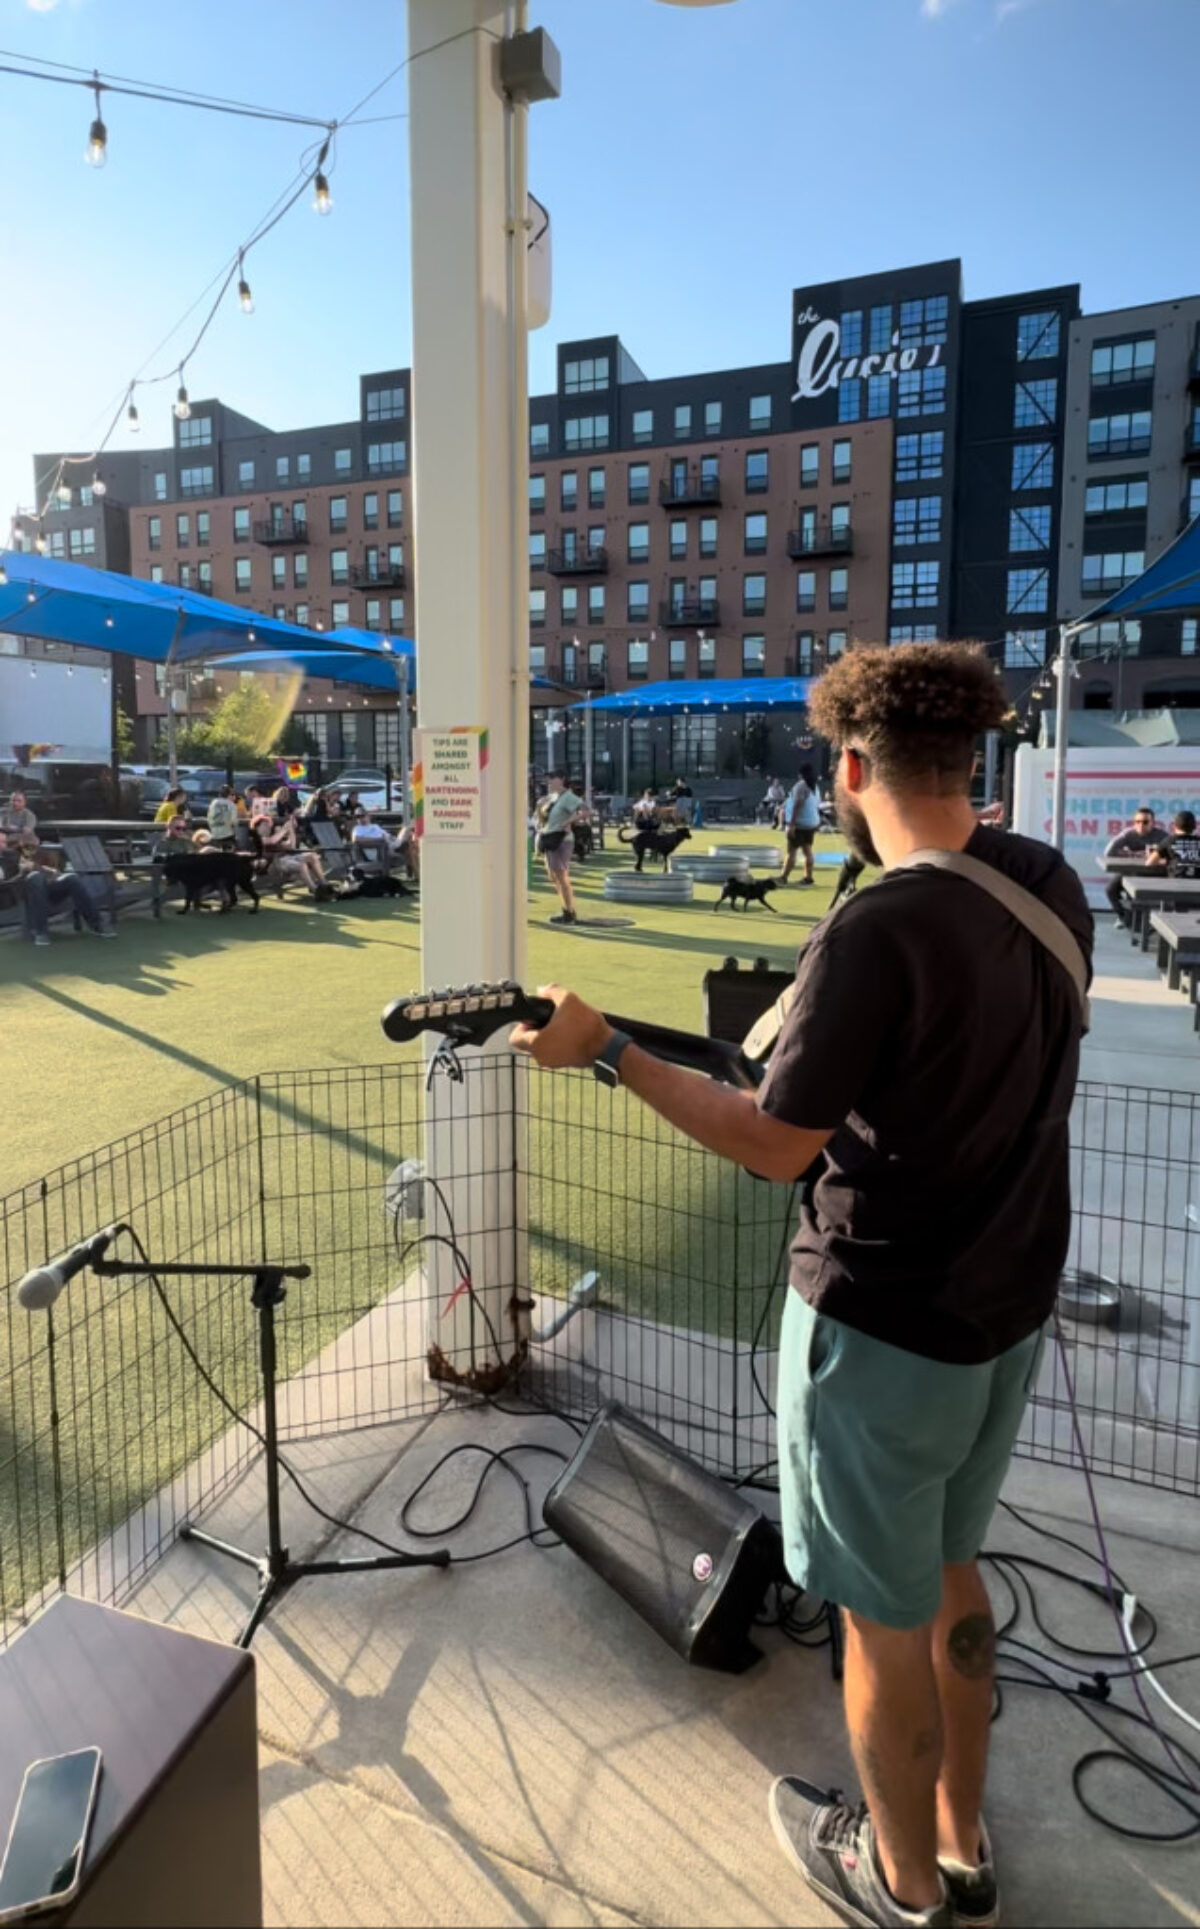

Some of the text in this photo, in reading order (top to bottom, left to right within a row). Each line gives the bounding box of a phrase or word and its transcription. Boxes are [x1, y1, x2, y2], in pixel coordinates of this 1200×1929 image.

[444, 775, 459, 783] ALL
[425, 786, 479, 795] BARTENDING
[431, 798, 448, 806] AND
[440, 822, 464, 830] STAFF
